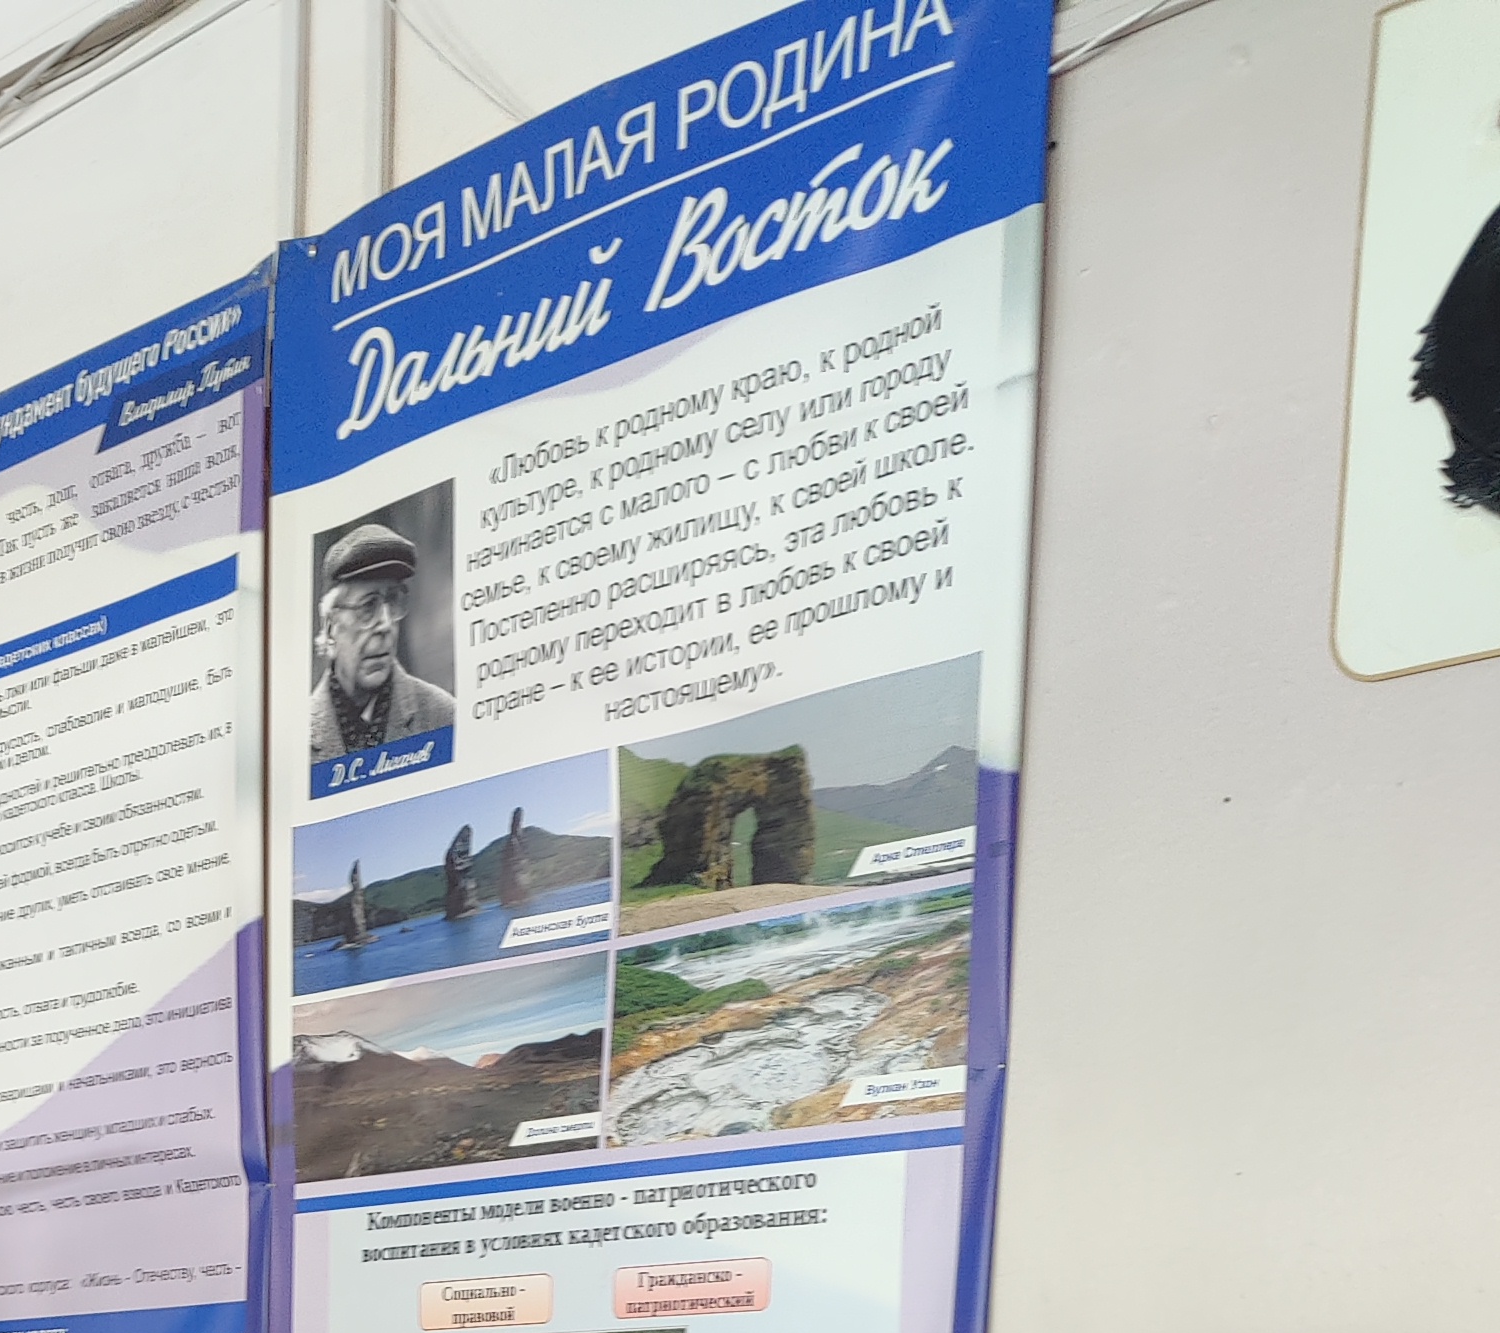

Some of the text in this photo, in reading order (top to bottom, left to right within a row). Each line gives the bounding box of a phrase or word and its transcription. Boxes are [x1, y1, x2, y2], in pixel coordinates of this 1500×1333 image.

[331, 0, 954, 303] МОЯ МАЛАЯ РОДИНА
[336, 138, 955, 440] Дальний Восток
[74, 340, 161, 406] будущего
[480, 348, 953, 534] культуре, к родному селу или городу
[488, 301, 943, 486] «Любовь к родному краю, к родной
[460, 431, 975, 613] семье, к своему жилищу, к своей школе.
[466, 510, 593, 573] начинается
[599, 503, 614, 527] с
[619, 472, 711, 521] малого
[743, 457, 760, 482] с
[766, 425, 858, 476] любви
[863, 417, 880, 443] к
[883, 379, 969, 435] своей
[469, 475, 964, 648] Постепенно расширяясь, эта любовь к
[476, 516, 950, 689] родному переходит в любовь к своей
[472, 681, 546, 722] стране
[570, 669, 584, 693] к
[588, 661, 620, 687] ее
[626, 631, 740, 679] истории,
[748, 618, 779, 646] ее
[784, 571, 928, 638] прошлому
[934, 564, 954, 591] и
[604, 661, 783, 723] настоящему».
[361, 1239, 461, 1263] воспитания
[478, 1230, 564, 1259] условиях
[567, 1220, 677, 1249] кадетского
[682, 1207, 828, 1241] образования:
[366, 1205, 477, 1232] Компоненты
[479, 1198, 546, 1221] модели
[548, 1192, 616, 1215] военно
[632, 1171, 817, 1209] патриотического
[441, 1285, 517, 1302] Социально
[451, 1306, 516, 1328] правовой
[625, 1290, 755, 1316] патриотический
[637, 1269, 733, 1293] Гражданско
